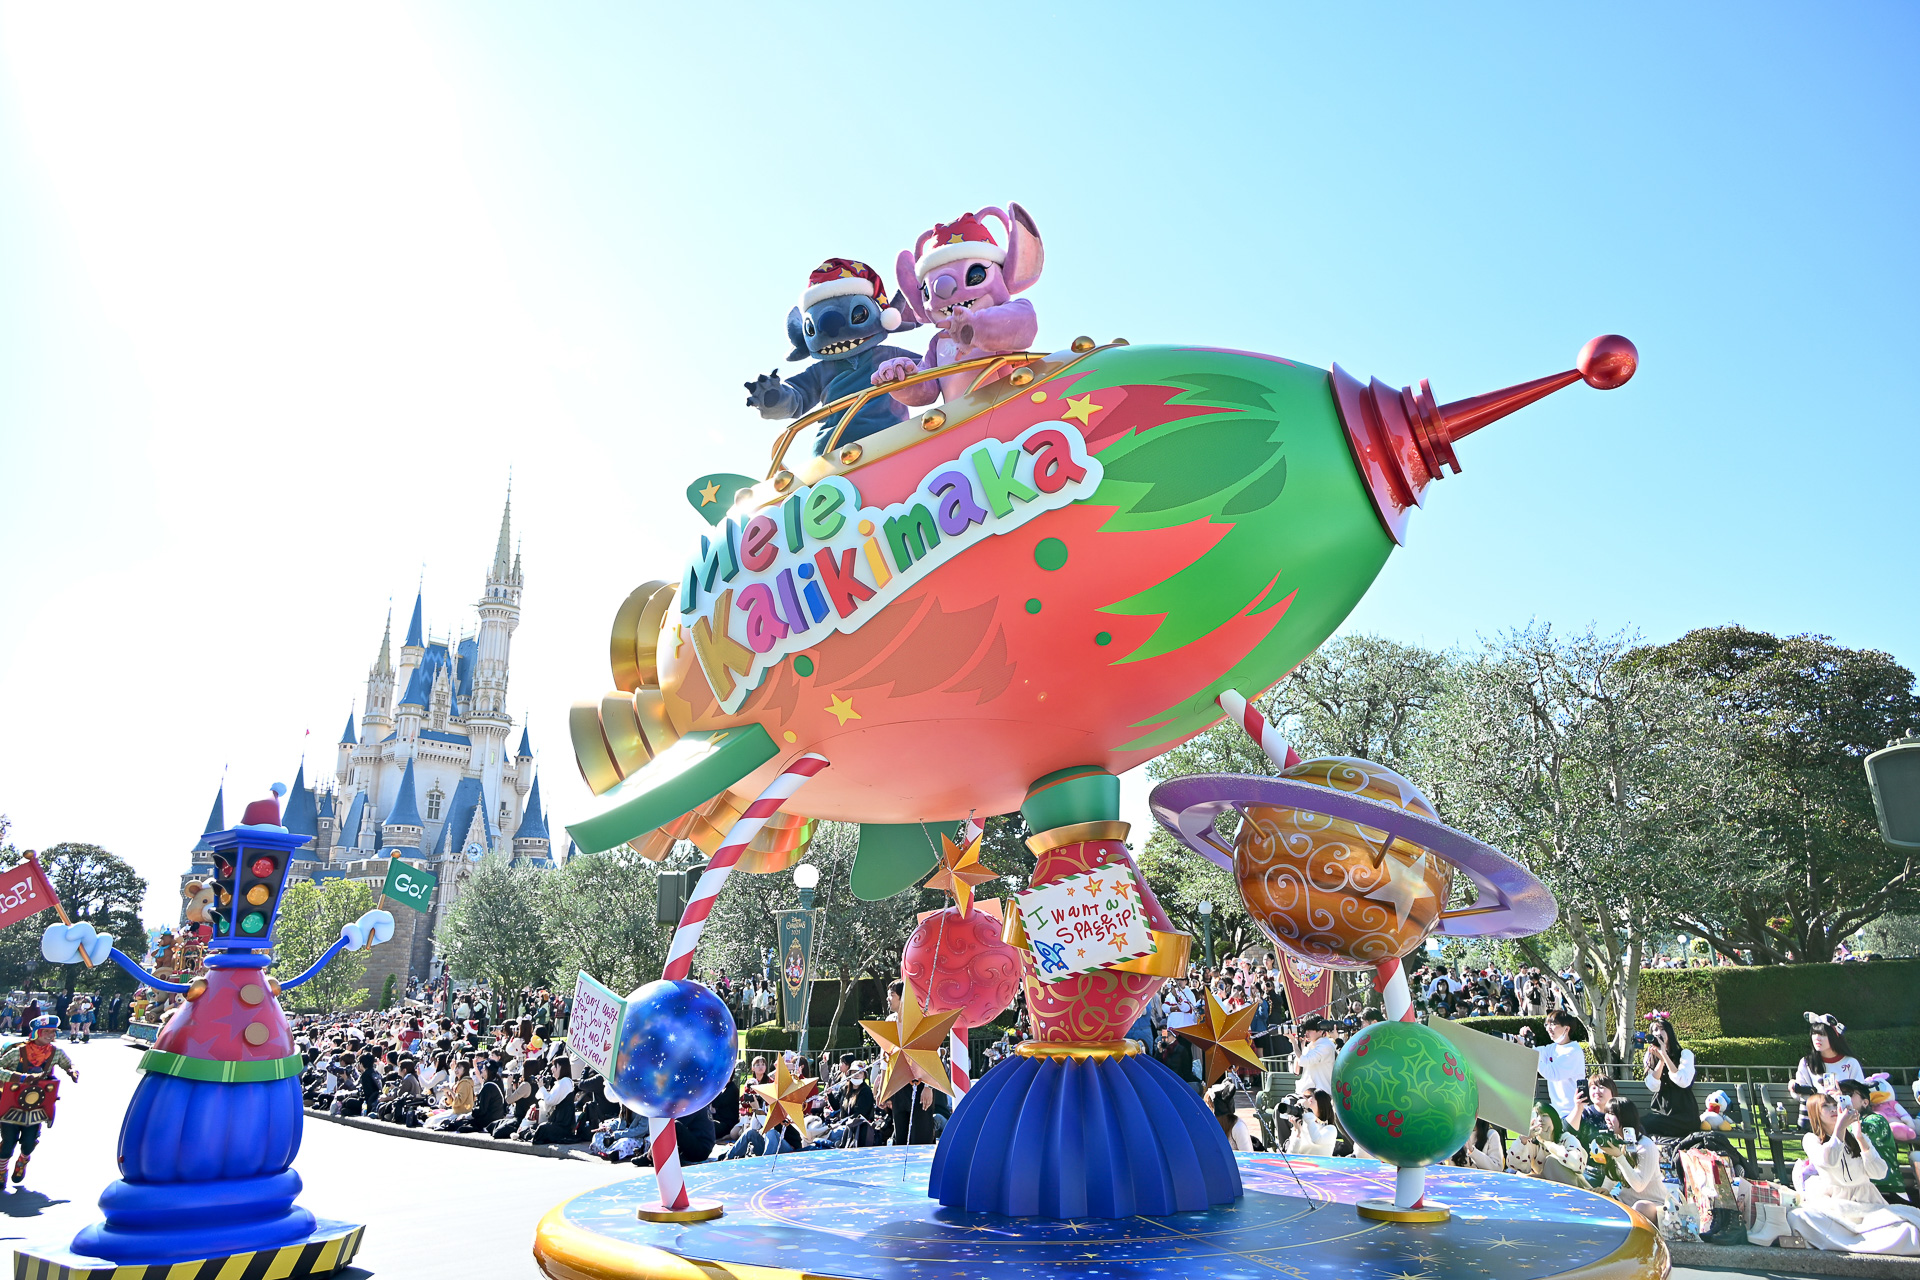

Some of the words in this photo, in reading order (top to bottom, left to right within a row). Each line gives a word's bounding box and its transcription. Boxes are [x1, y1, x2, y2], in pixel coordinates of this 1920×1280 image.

[681, 483, 846, 614] Mele
[691, 430, 1087, 702] Kalikimaka
[1027, 905, 1049, 931] I
[1106, 898, 1119, 911] a
